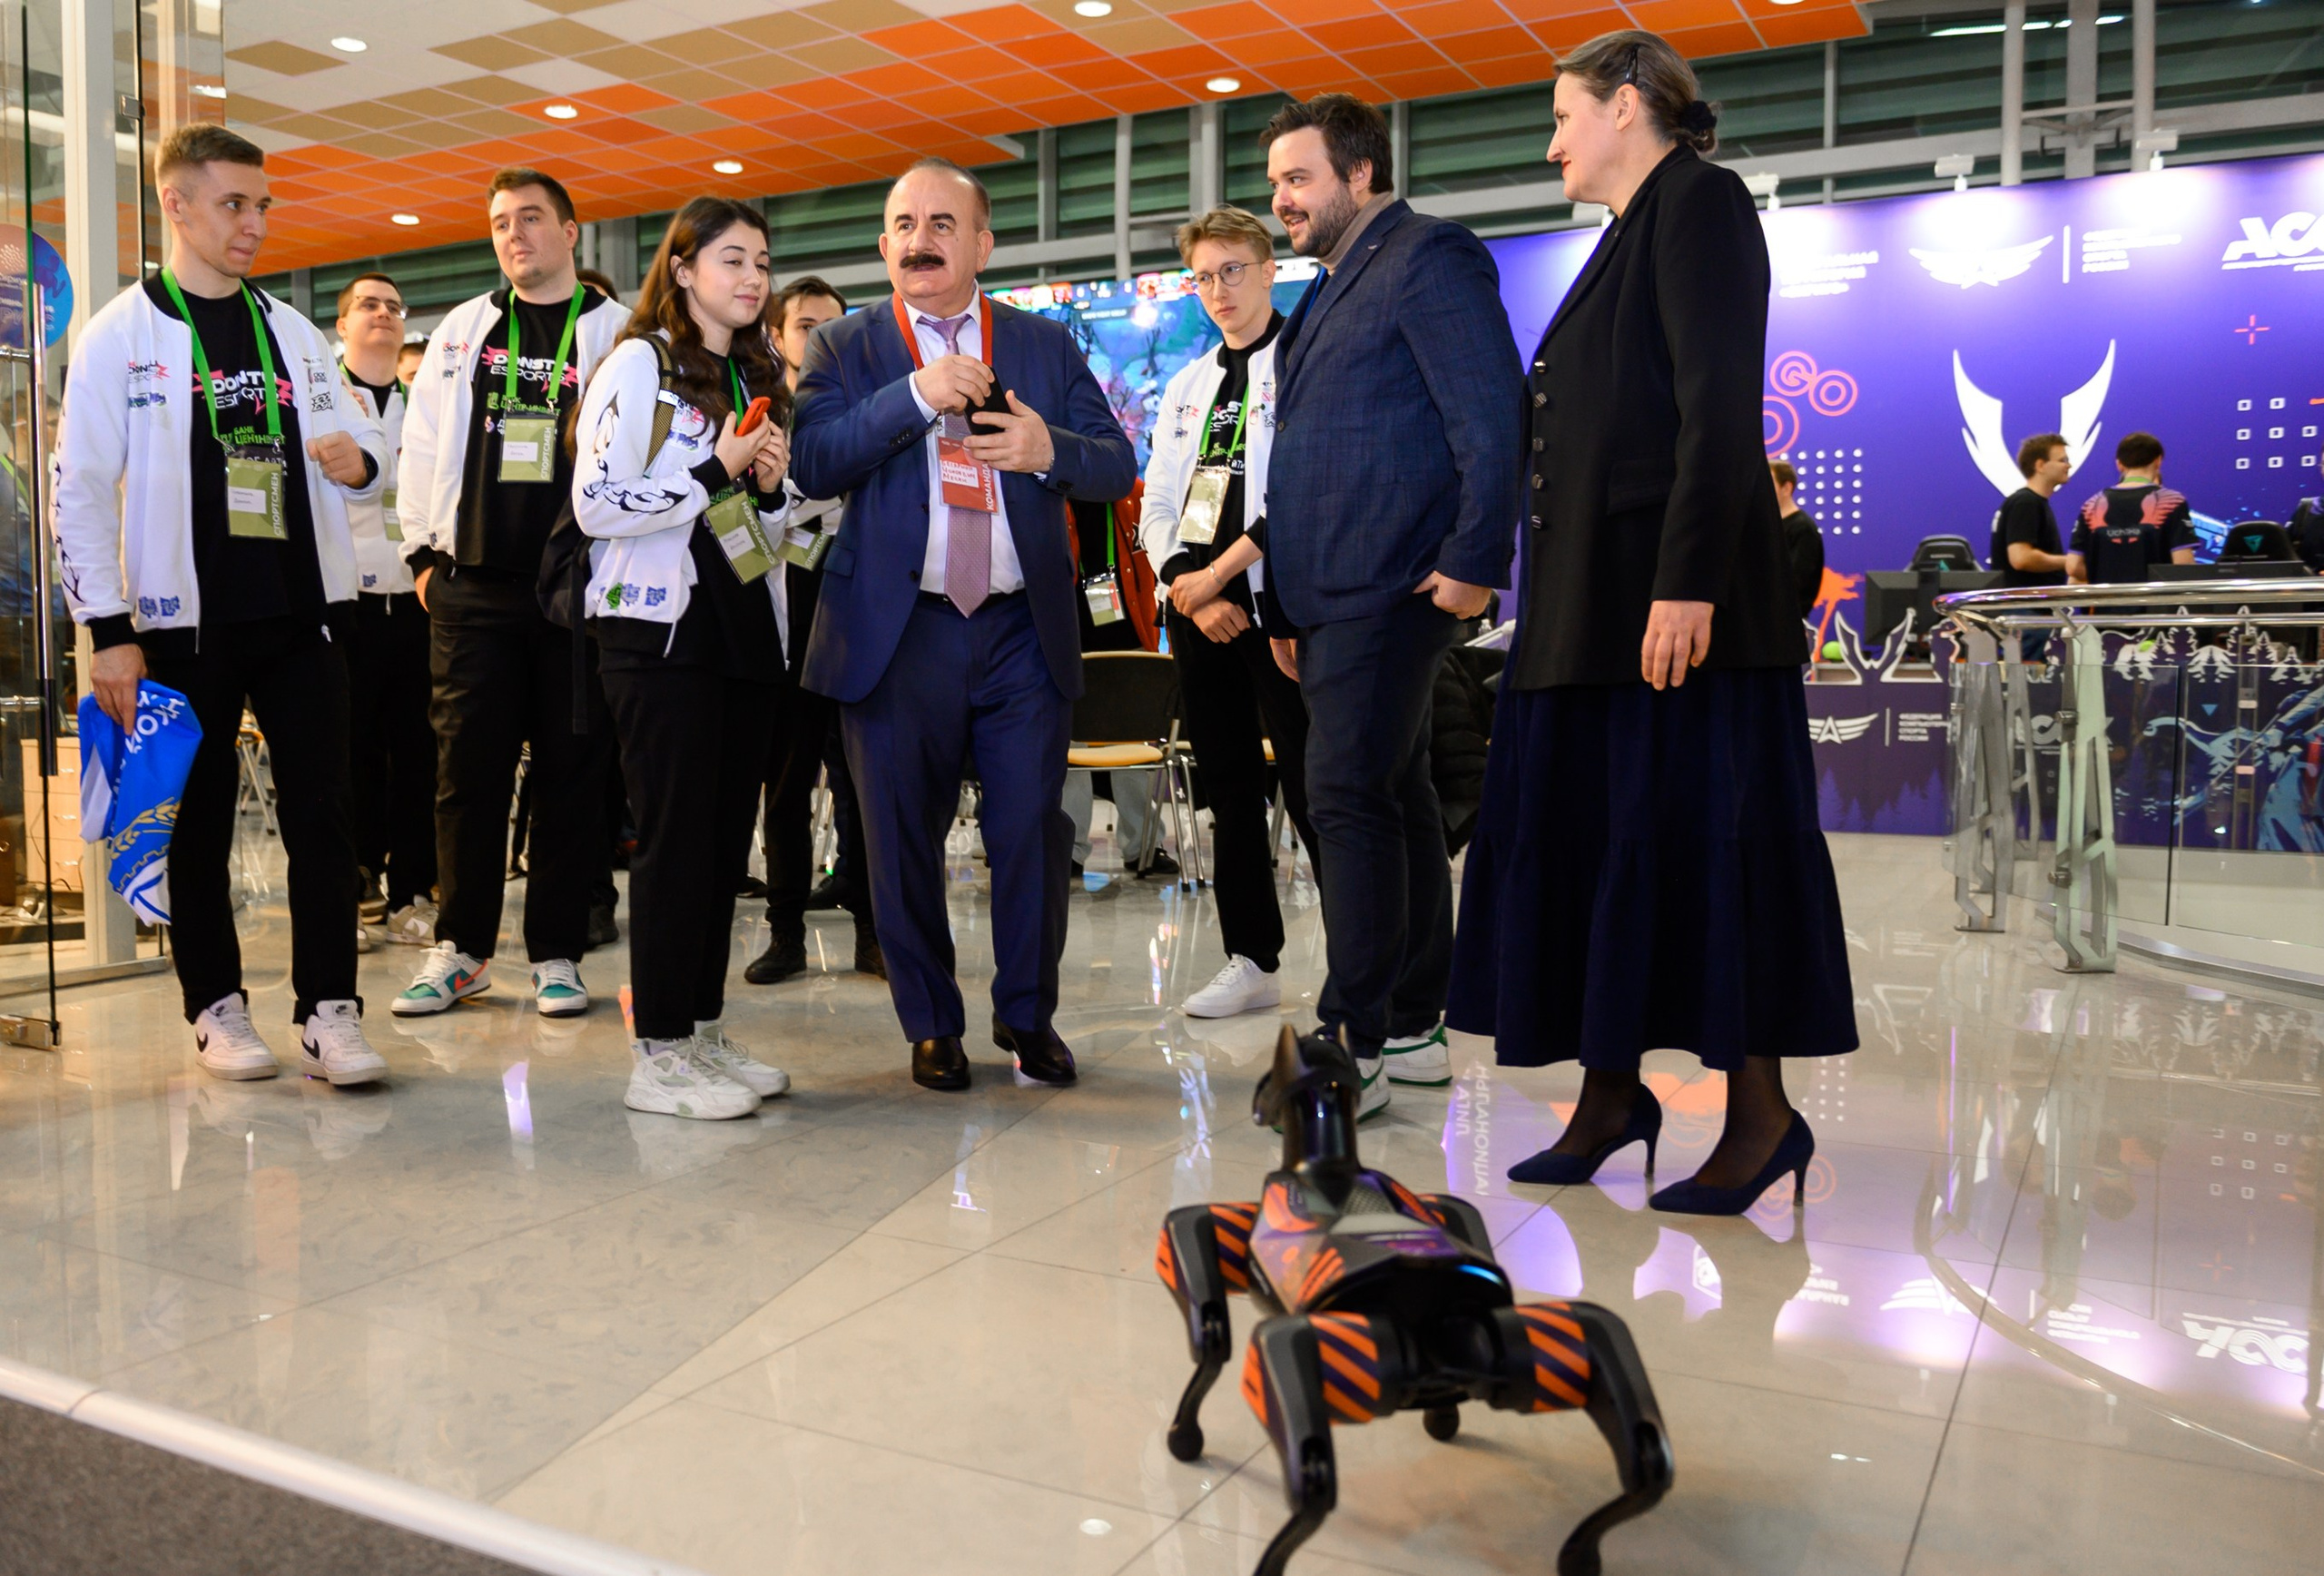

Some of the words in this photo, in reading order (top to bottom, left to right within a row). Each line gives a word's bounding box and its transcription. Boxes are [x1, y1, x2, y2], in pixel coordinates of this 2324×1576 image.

[540, 427, 552, 479] СПОРТСМЕН
[271, 472, 282, 537] СПОРТСМЕН
[982, 463, 995, 511] КОМАНДА
[741, 500, 776, 565] СПОРТСМЕН
